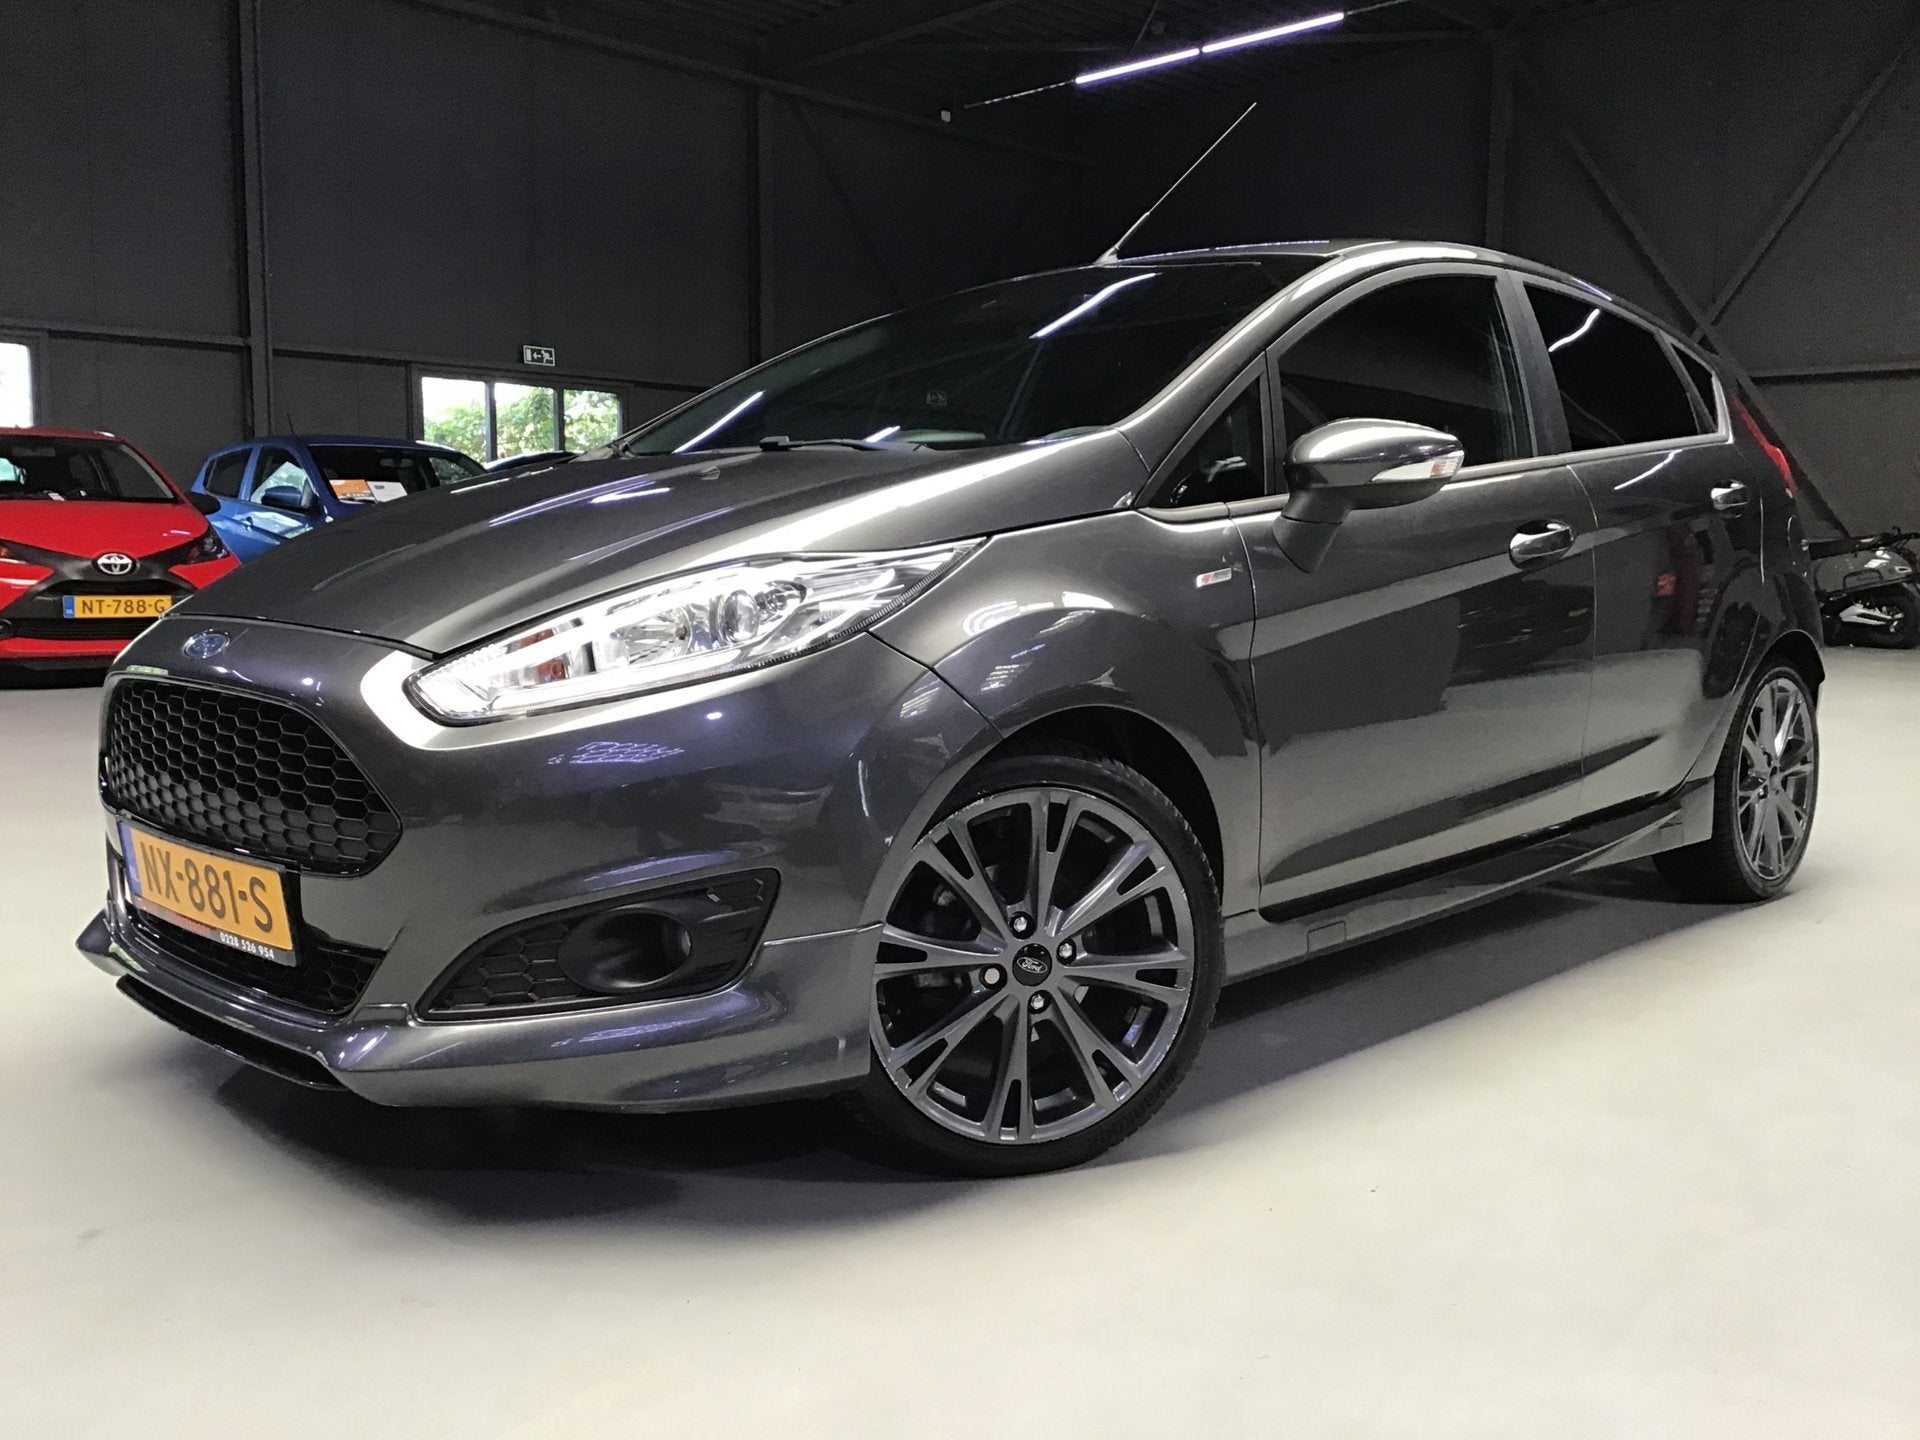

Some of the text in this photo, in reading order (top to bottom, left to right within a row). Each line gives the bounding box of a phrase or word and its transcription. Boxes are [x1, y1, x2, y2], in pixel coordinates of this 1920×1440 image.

[82, 599, 166, 614] NT-788-G
[140, 841, 273, 933] NX-881-S
[220, 931, 275, 960] 0228 526 954
[1021, 958, 1043, 972] Ford
